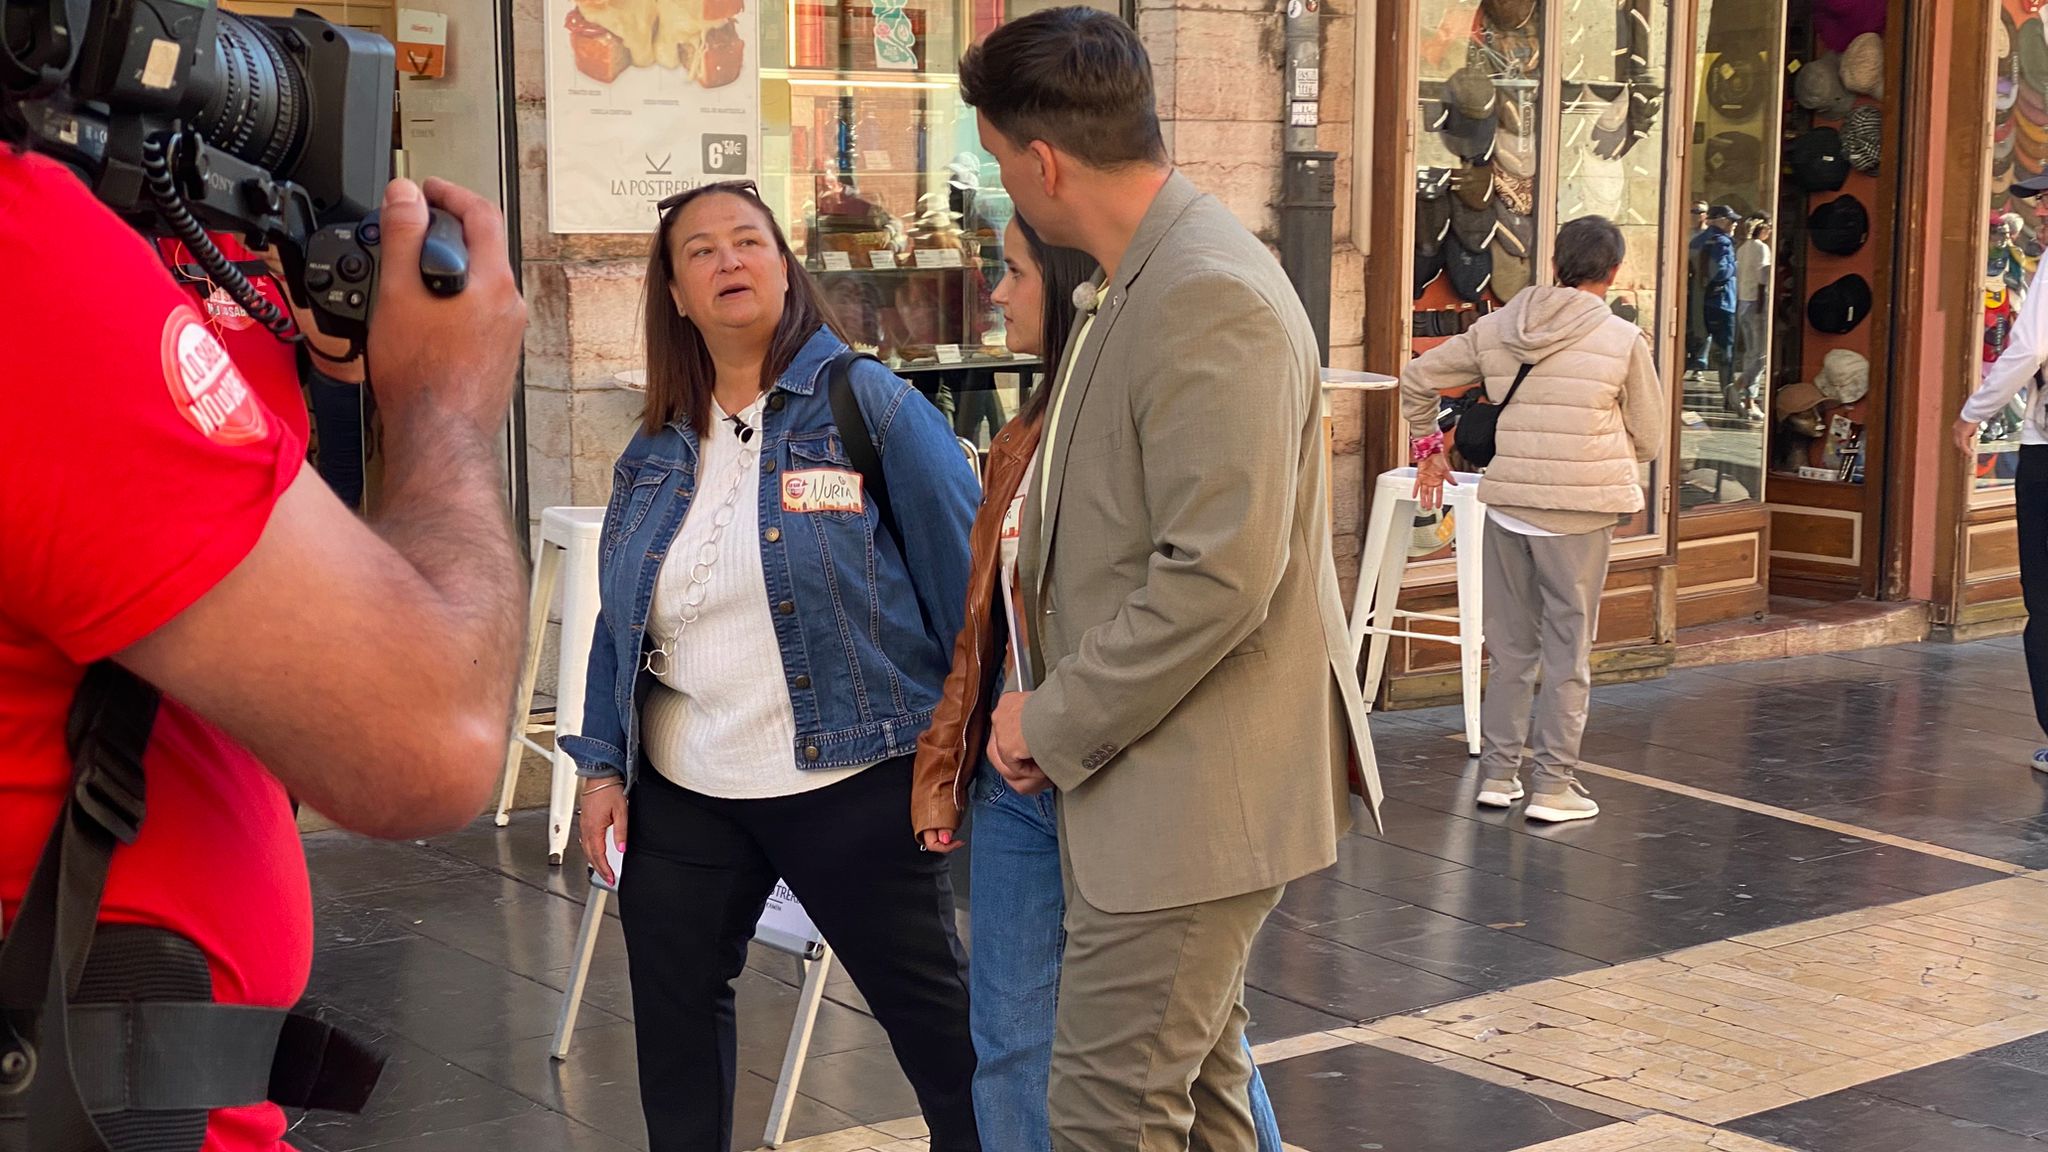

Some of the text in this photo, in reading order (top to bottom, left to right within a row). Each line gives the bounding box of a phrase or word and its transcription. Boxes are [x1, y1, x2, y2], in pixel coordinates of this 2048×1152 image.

[611, 180, 627, 195] LA
[180, 353, 206, 385] LO
[188, 392, 227, 437] NO
